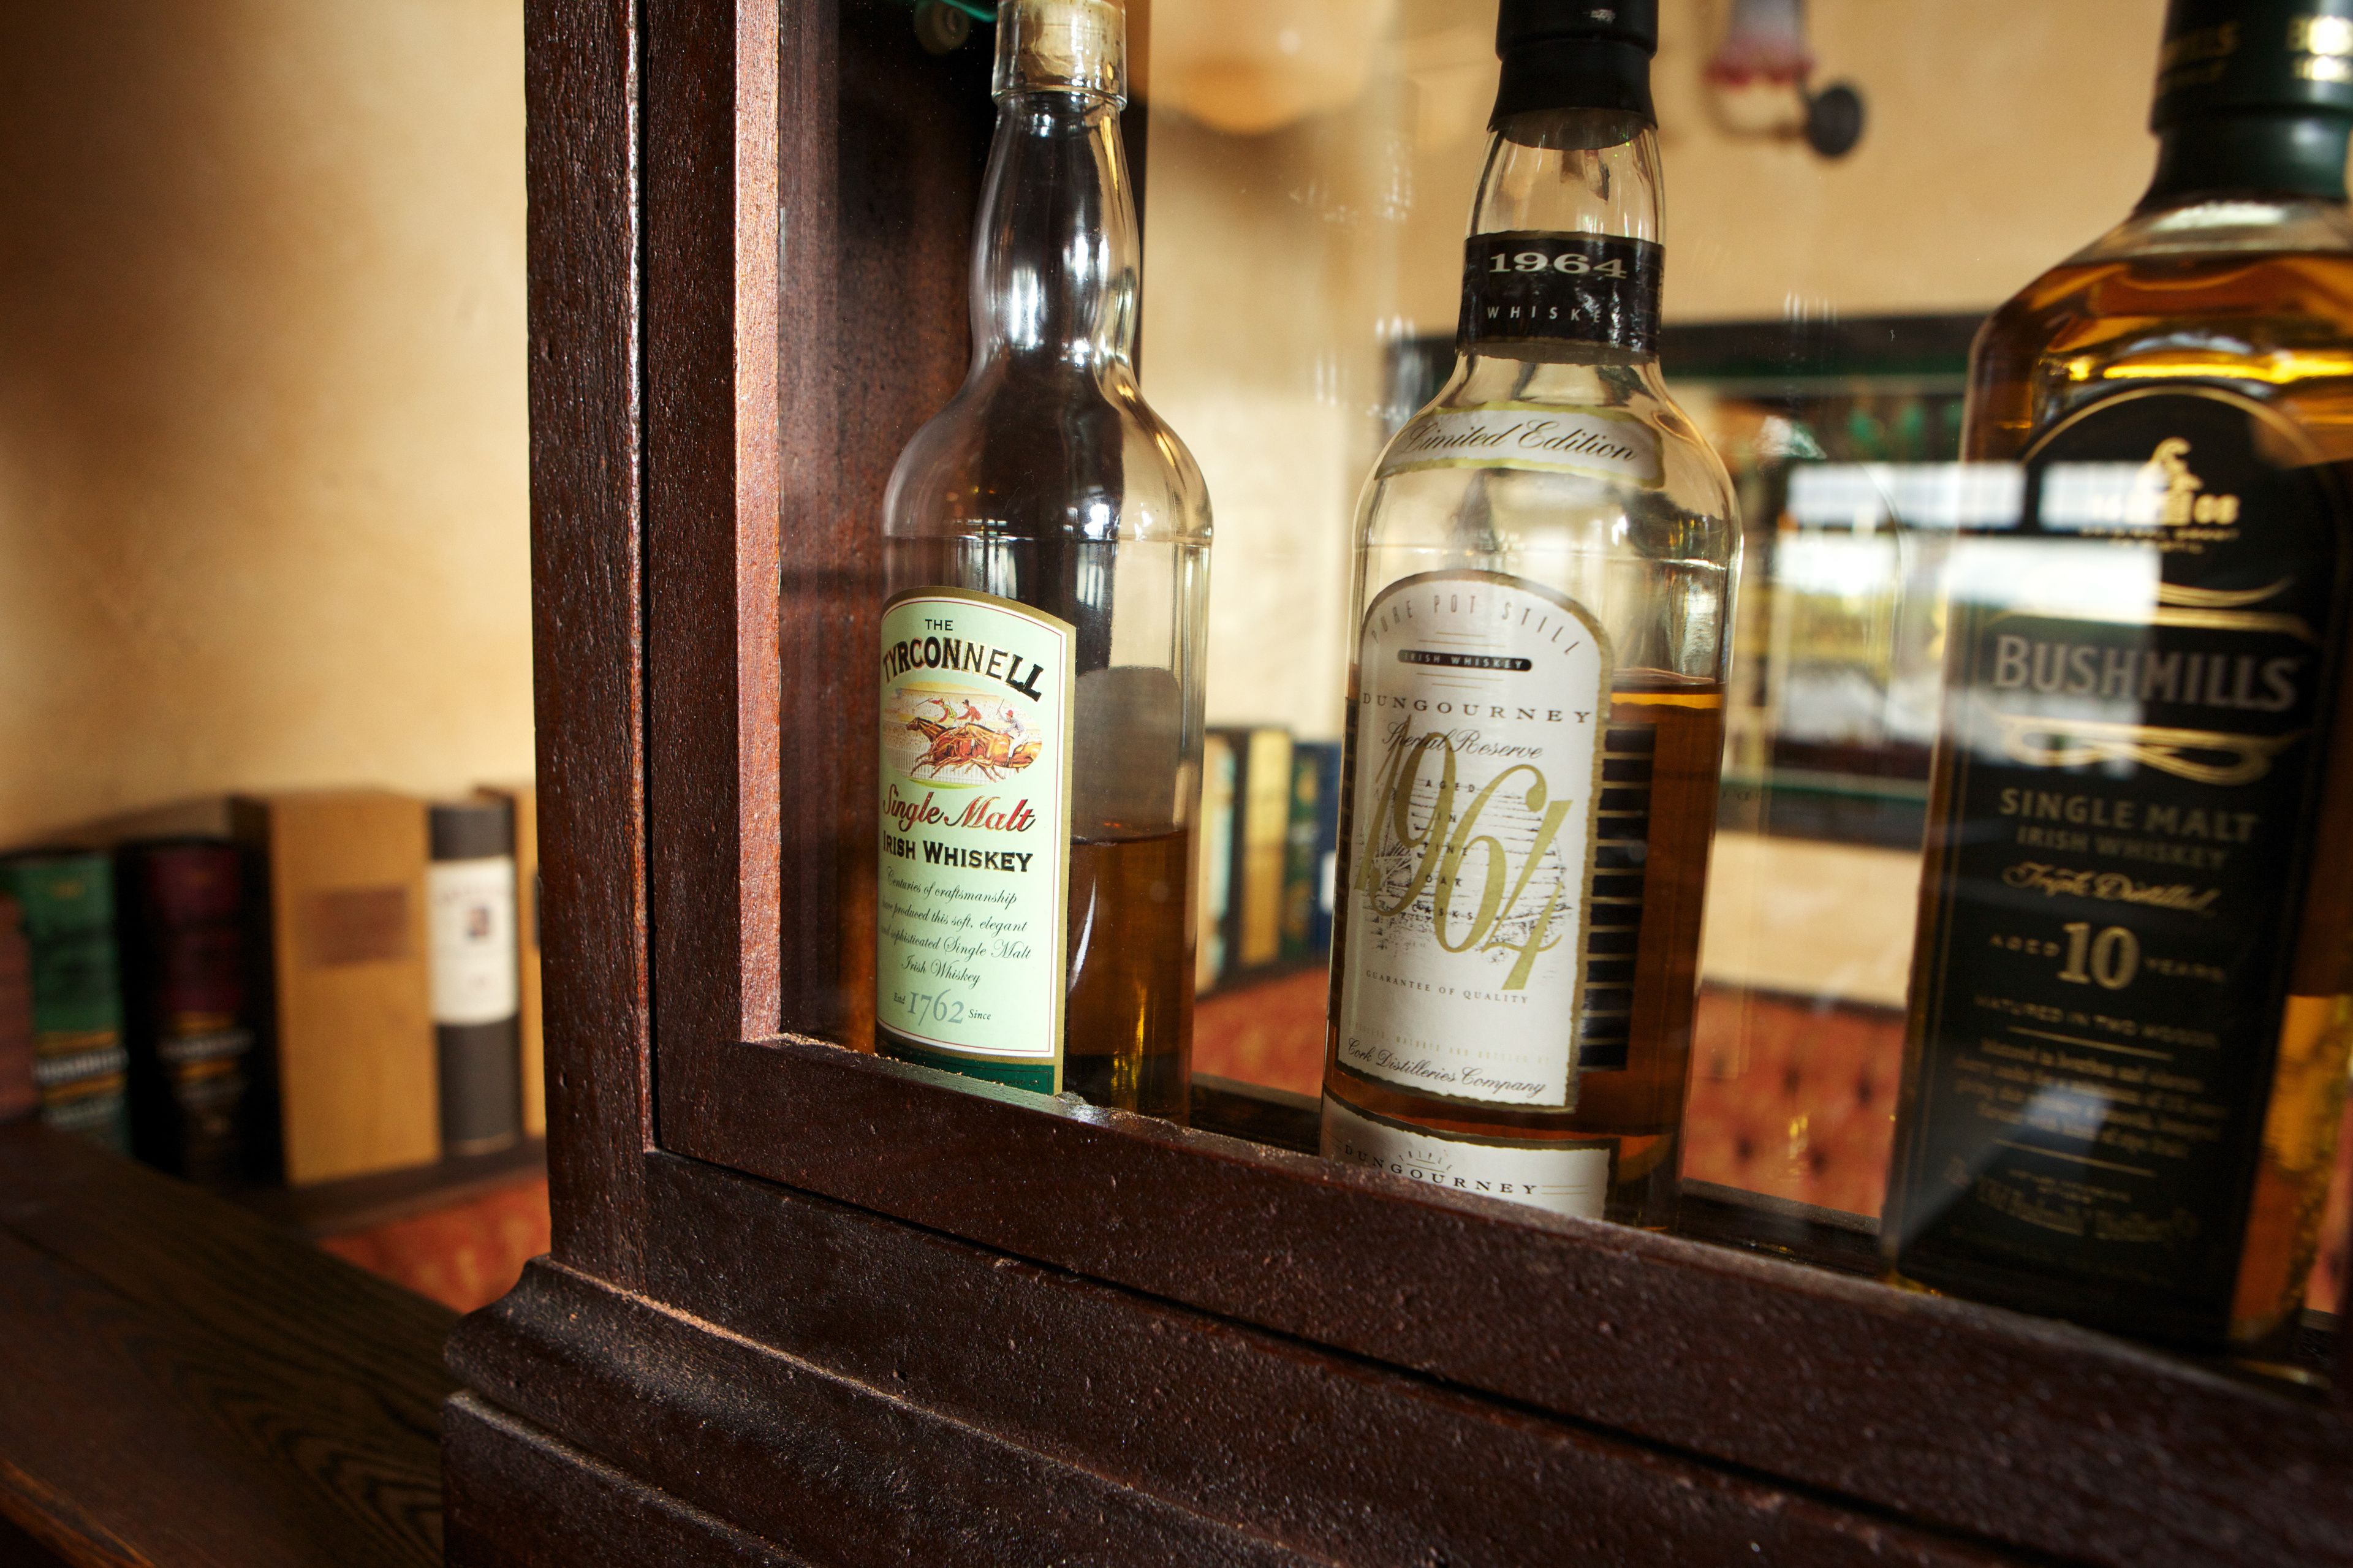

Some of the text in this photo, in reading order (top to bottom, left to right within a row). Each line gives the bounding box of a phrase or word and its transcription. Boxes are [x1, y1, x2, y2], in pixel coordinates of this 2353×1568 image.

[1488, 252, 1627, 279] 1964
[1487, 306, 1618, 325] WHISKE
[1399, 419, 1637, 461] Limited Edition
[925, 619, 953, 631] THE
[1371, 594, 1580, 655] PURE POT STILL
[883, 636, 1044, 702] TYRCONNELL
[1403, 651, 1524, 669] IRISH WHISKEY
[1993, 634, 2302, 713] BUSHMILLS
[1363, 692, 1593, 724] DUNGOURNEY
[1382, 722, 1543, 759] Special Reserve
[1425, 779, 1476, 793] AGED
[883, 784, 1036, 832] Single Malt
[1438, 812, 1457, 824] IN
[1999, 787, 2261, 843] SINGLE MALT
[883, 830, 1034, 873] IRISH WHISKEY
[1354, 713, 1573, 990] 1964
[1422, 841, 1468, 856] FINE
[2016, 825, 2090, 853] IRISH
[887, 866, 1017, 911] Centuries of craftsmanship
[1425, 874, 1462, 888] OAK
[892, 902, 931, 921] produced
[931, 909, 949, 925] this
[951, 914, 973, 933] soft,
[979, 917, 1028, 937] elegant
[1412, 904, 1474, 920] CASKS
[943, 936, 988, 962] Single
[991, 939, 1032, 960] Malt
[2057, 920, 2141, 991] 10
[901, 955, 982, 990] Irish Whiskey
[1366, 969, 1529, 1005] GUARANTEE OF QUALITY
[907, 988, 966, 1026] 1762
[968, 1009, 992, 1021] Since
[1347, 1037, 1373, 1061] Cork
[1375, 1049, 1457, 1083] Distilleries
[1461, 1066, 1547, 1099] Company
[1344, 1143, 1537, 1195] DUNGOURNEY
